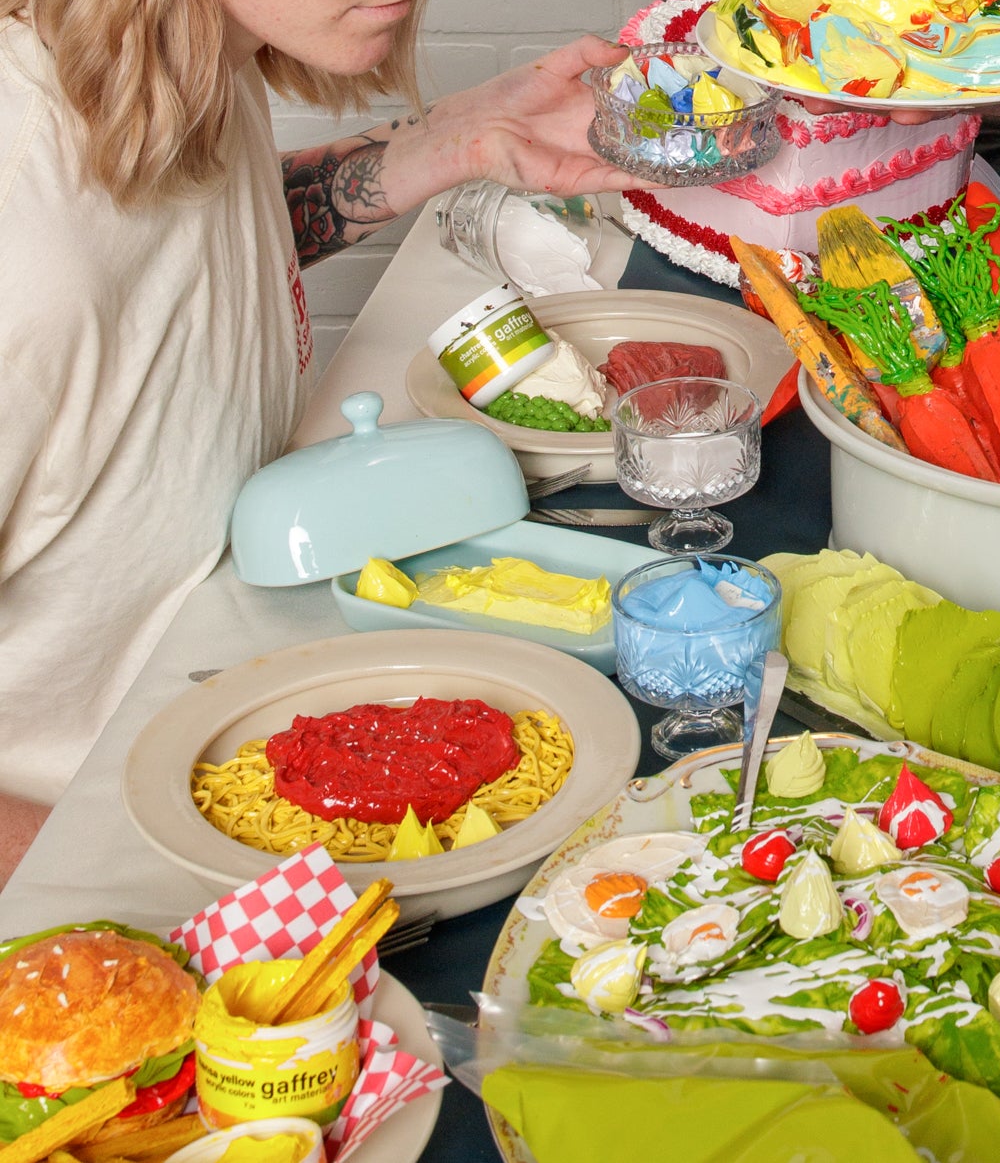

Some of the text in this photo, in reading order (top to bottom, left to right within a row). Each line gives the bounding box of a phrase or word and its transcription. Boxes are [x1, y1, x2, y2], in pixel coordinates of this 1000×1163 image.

[494, 312, 534, 341] gaffrey
[460, 335, 492, 362] chartree
[220, 1073, 256, 1087] yellow
[261, 1064, 338, 1100] gaffrey
[228, 1088, 256, 1099] colors
[272, 1095, 287, 1104] art
